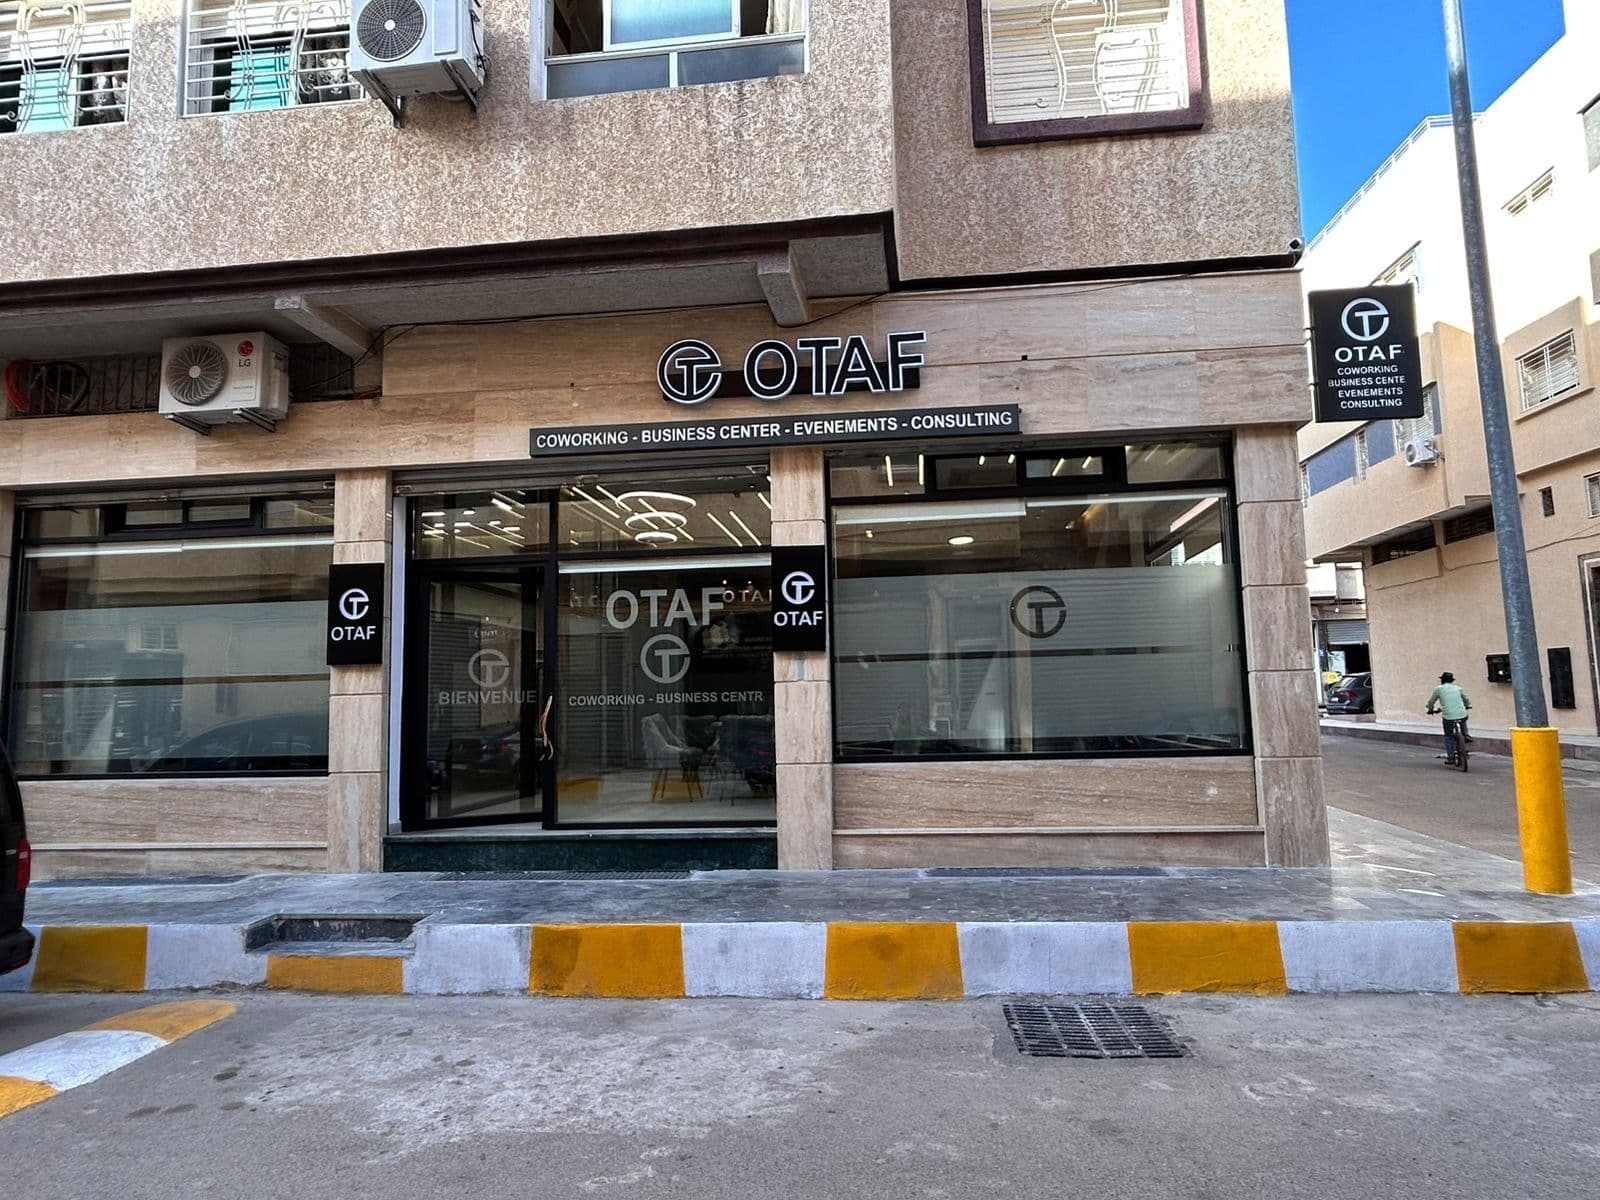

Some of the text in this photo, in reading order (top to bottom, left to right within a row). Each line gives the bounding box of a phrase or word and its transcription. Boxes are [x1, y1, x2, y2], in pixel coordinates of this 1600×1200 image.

[1335, 344, 1402, 363] OTAF
[238, 358, 252, 367] LG
[743, 330, 927, 400] OTAF
[1337, 365, 1398, 376] COWORKING
[1328, 375, 1406, 388] BUSINESS CENTE
[1338, 387, 1404, 398] EVENEMENTS
[1340, 398, 1403, 409] CONSULTING
[536, 431, 629, 448] COWORKING
[641, 426, 716, 443] BUSINESS
[720, 423, 781, 440] CENTER
[794, 417, 898, 436] EVENEMENTS
[911, 411, 1012, 430] CONSULTING
[606, 587, 726, 629] OTAF
[774, 611, 824, 626] OTAF
[331, 625, 376, 641] OTAF
[438, 690, 537, 705] BIENVENUE
[569, 694, 645, 706] COWORKING
[656, 692, 718, 704] BUSINESS
[722, 691, 764, 702] CENTR
